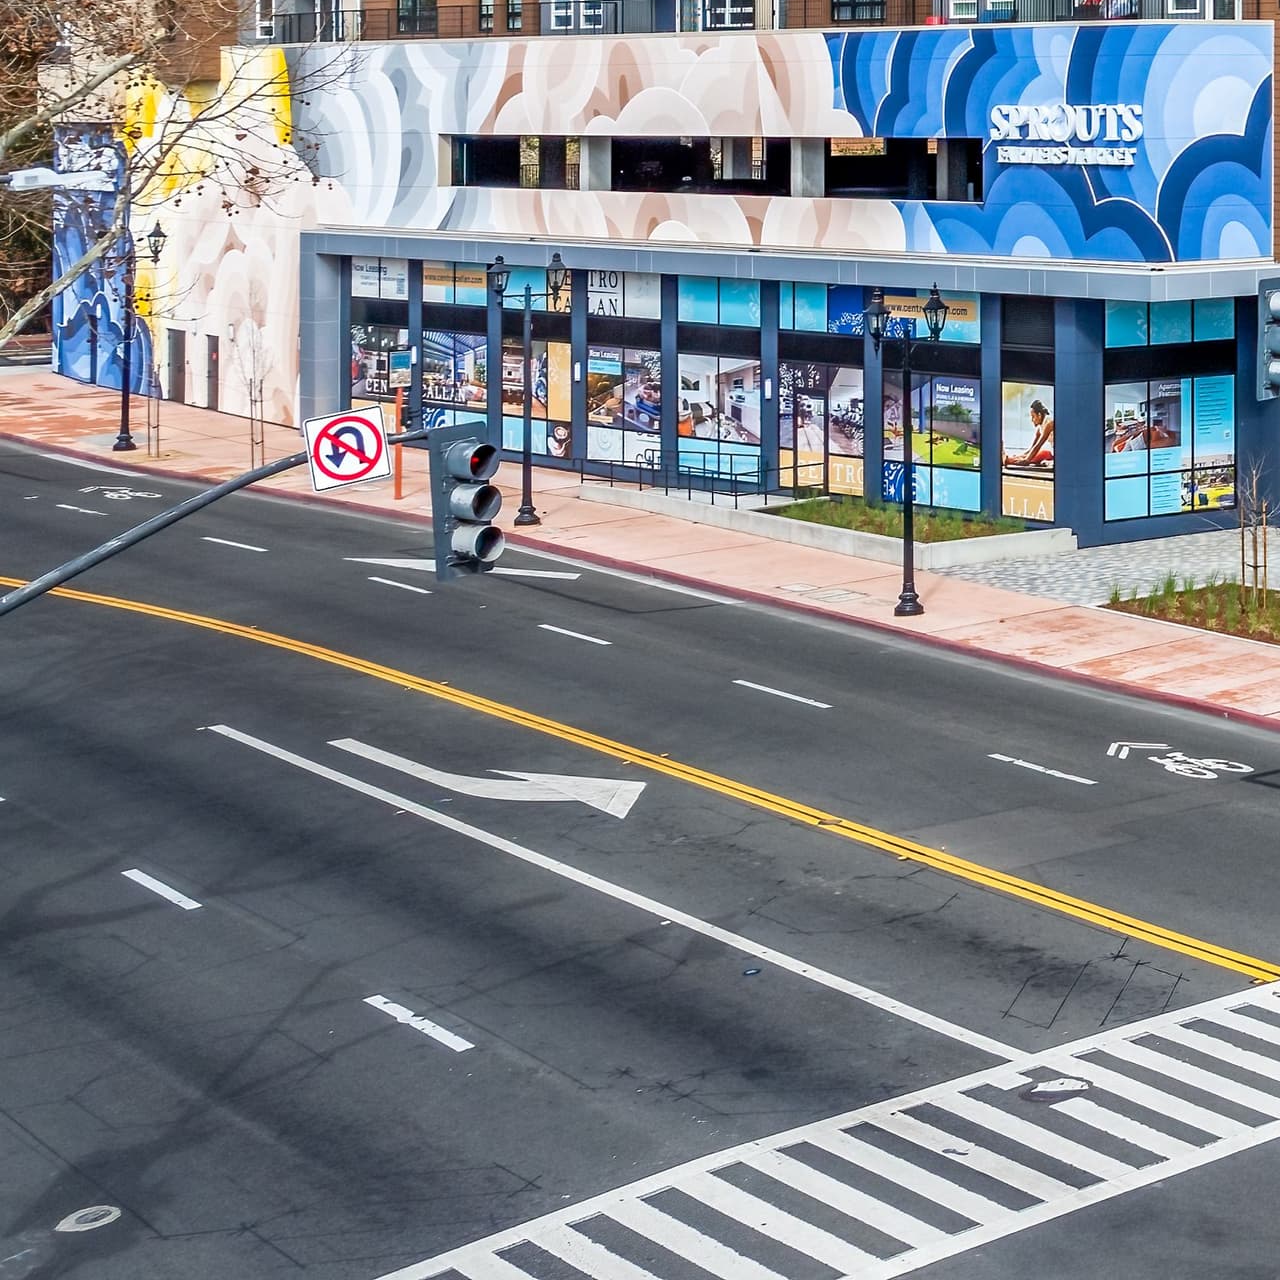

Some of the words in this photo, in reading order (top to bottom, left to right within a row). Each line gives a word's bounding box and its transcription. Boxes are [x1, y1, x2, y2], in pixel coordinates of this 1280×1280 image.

[990, 104, 1144, 142] SPROUTS
[936, 384, 950, 392] Now
[951, 385, 974, 397] Leasing
